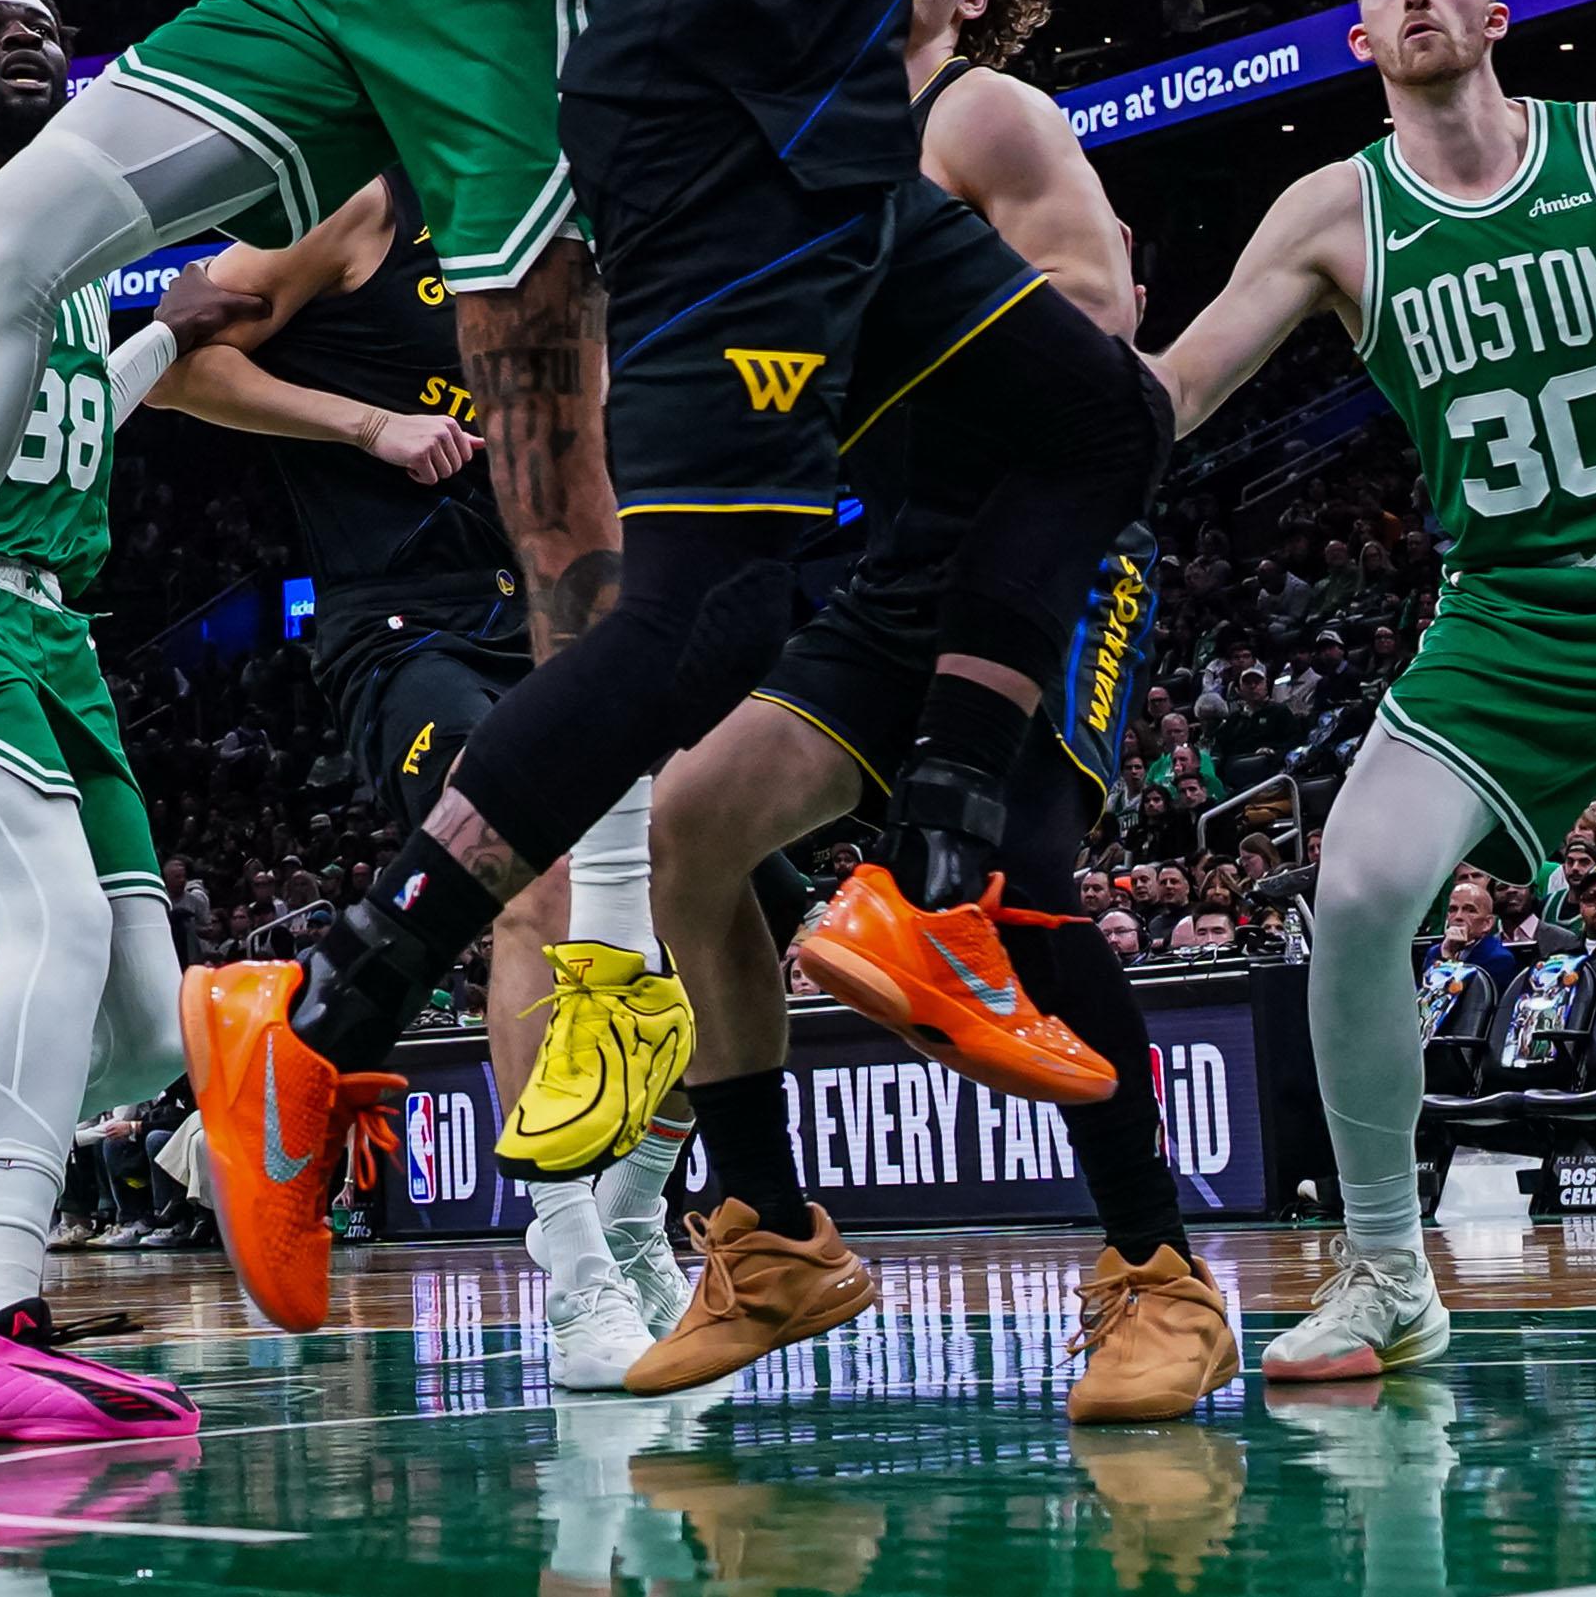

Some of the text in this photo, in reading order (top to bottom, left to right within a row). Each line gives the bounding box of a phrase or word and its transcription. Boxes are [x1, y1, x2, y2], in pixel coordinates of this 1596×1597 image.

[1063, 45, 1299, 137] ore at UG2.com
[1529, 192, 1593, 218] Amica
[813, 1061, 960, 1188] EVERY
[974, 1081, 1076, 1182] FAN
